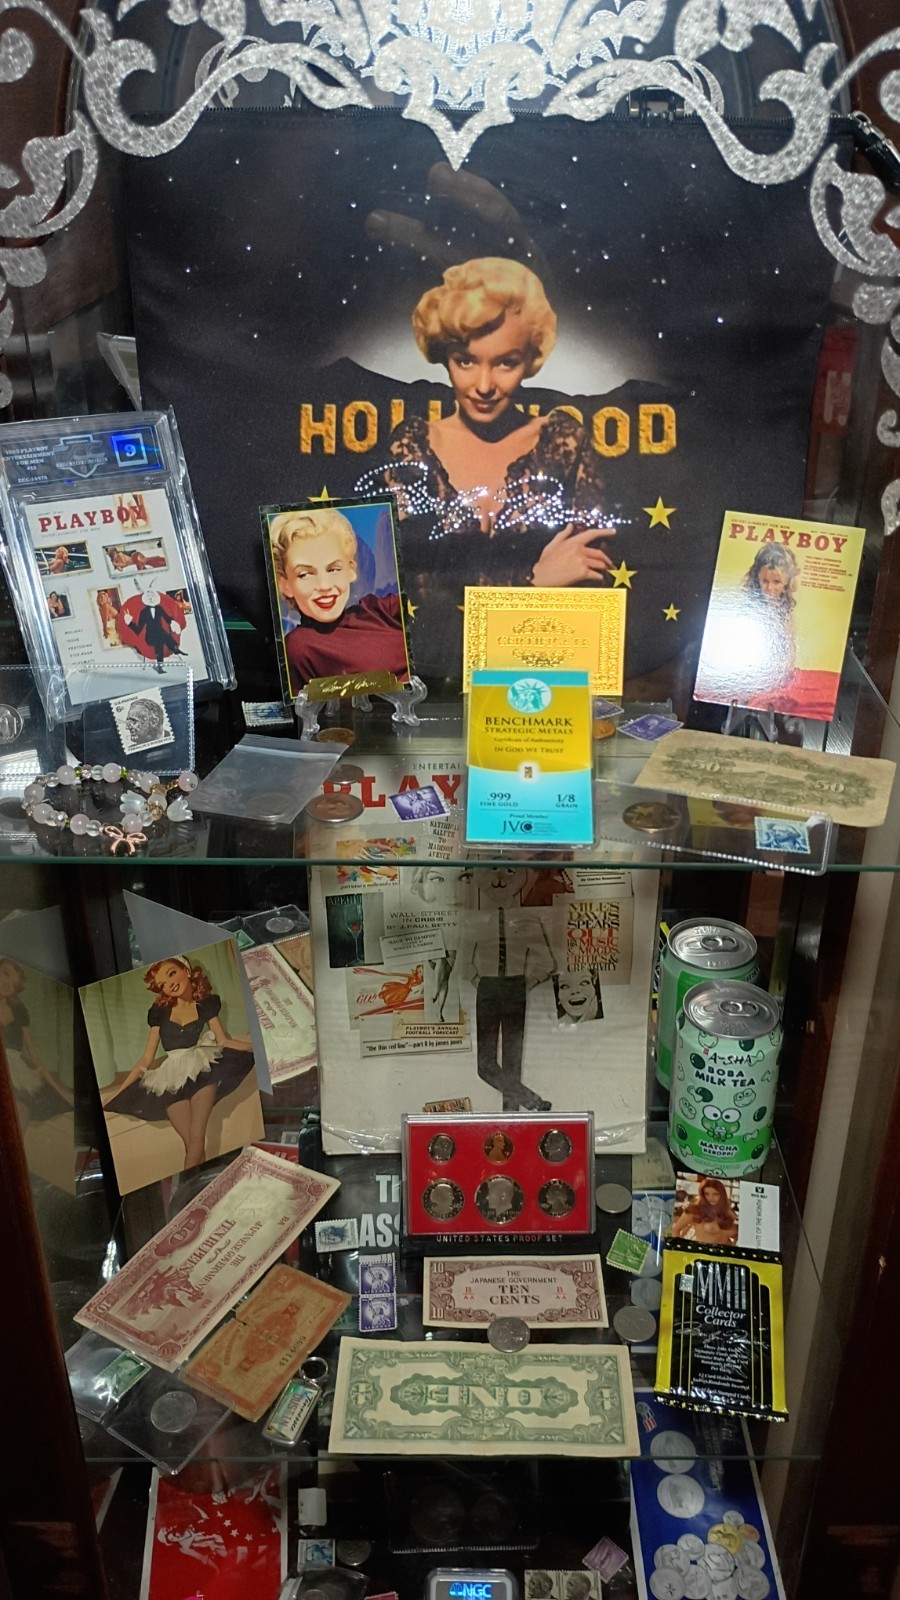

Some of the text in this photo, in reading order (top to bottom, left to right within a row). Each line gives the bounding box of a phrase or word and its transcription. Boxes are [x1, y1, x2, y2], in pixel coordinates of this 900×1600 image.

[124, 444, 136, 457] 9
[38, 505, 145, 532] PLAYBOY
[729, 523, 848, 553] PLAYBOY
[498, 636, 589, 647] CERTIFICATE
[485, 717, 573, 726] BENCHMARK
[814, 780, 845, 793] 50
[487, 792, 575, 803] .999 1/8
[439, 836, 447, 844] TO
[568, 902, 620, 912] MILES
[389, 910, 459, 919] WALL STREET
[569, 911, 620, 921] DAVIS
[567, 920, 620, 929] SPEAKS
[567, 928, 619, 939] OUT
[579, 938, 619, 947] MUSIC
[567, 955, 618, 964] CRITICS &
[567, 962, 616, 972] CREATIVITY
[708, 1066, 744, 1077] BOBA
[695, 1071, 756, 1087] MILK TEA
[700, 1141, 738, 1151] MATCHA
[703, 1148, 733, 1156] KEROPPI
[213, 1219, 236, 1245] TEN
[234, 1220, 263, 1252] JAPANESE
[436, 1235, 470, 1243] UNITED
[473, 1235, 510, 1243] STATES
[512, 1235, 542, 1243] PROOF
[231, 1254, 246, 1269] THE
[582, 1261, 594, 1273] 10
[432, 1262, 444, 1273] 10
[498, 1285, 530, 1294] TEN
[489, 1295, 540, 1305] CENTS
[432, 1307, 444, 1319] 10
[588, 1308, 599, 1320] 10
[695, 1304, 746, 1320] Collector
[704, 1314, 737, 1328] Cards
[426, 1384, 545, 1409] ONE
[463, 1583, 492, 1598] NGC
